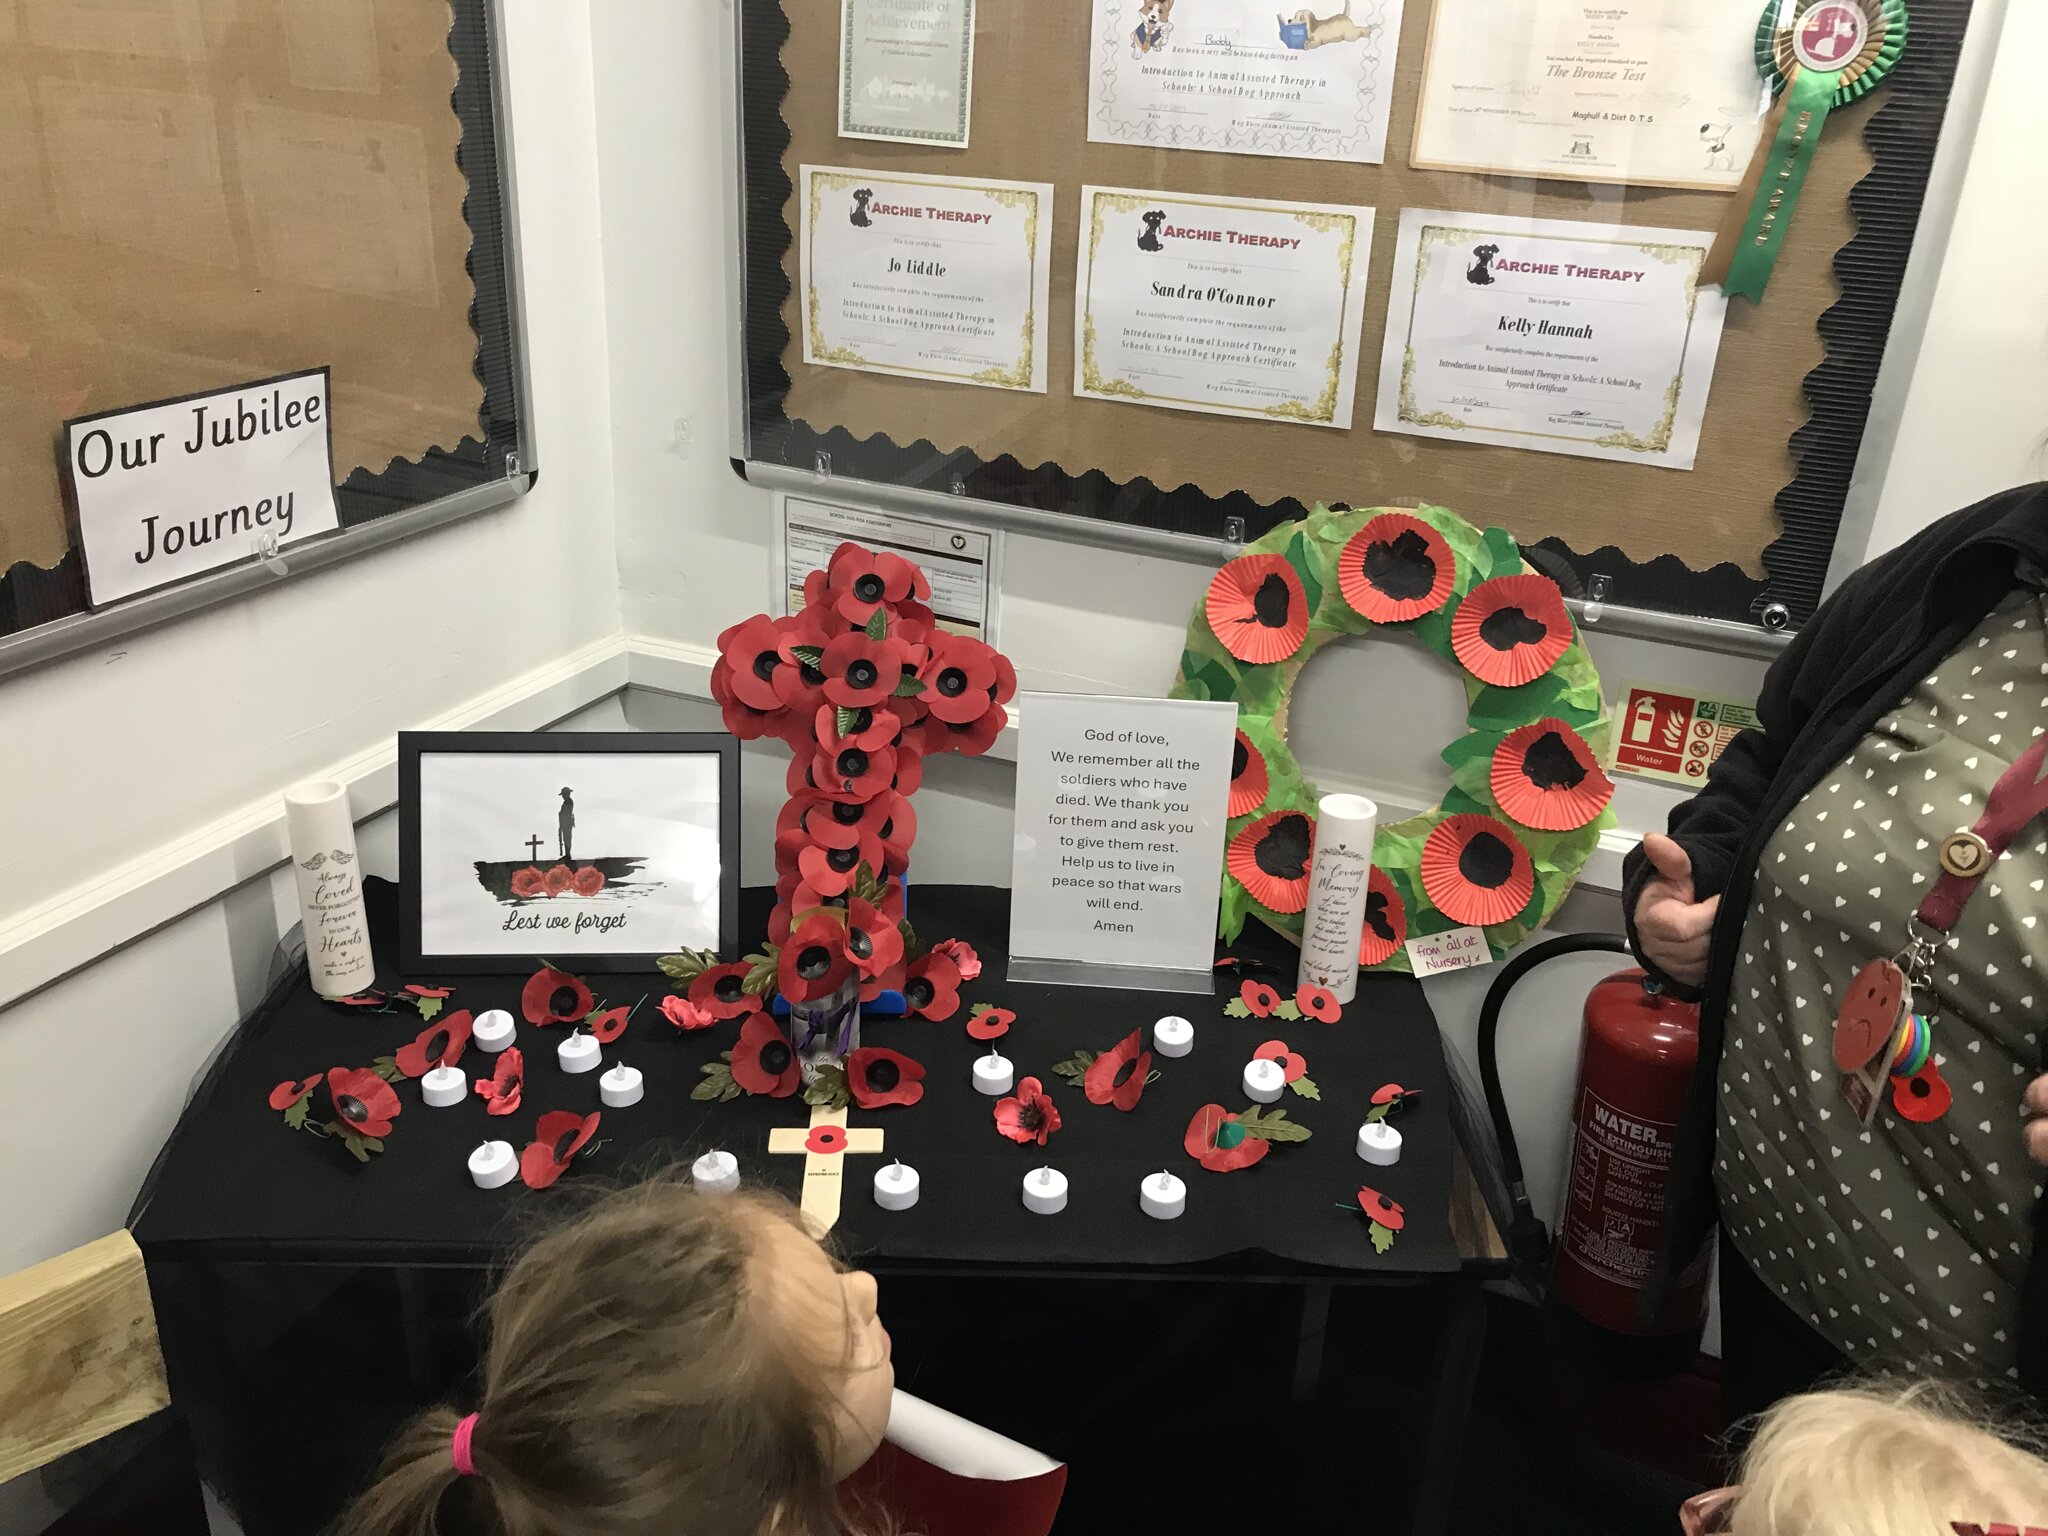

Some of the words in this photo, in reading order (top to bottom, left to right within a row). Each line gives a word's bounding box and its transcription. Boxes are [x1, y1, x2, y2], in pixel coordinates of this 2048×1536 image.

[865, 14, 950, 31] Achievement
[1142, 65, 1193, 78] Introduction
[1196, 70, 1204, 78] to
[1208, 70, 1239, 81] Animal
[1240, 71, 1276, 83] Assisted
[1280, 75, 1315, 88] Therapy
[1318, 78, 1326, 86] in
[1546, 64, 1569, 77] The
[1572, 66, 1617, 80] Bronze
[1622, 68, 1646, 81] Test
[1208, 85, 1236, 96] School
[1238, 88, 1255, 98] Dog
[1258, 90, 1300, 100] Approach
[1572, 111, 1600, 121] Maghull
[888, 258, 901, 272] Jo
[907, 259, 946, 278] Liddle
[1150, 281, 1202, 301] Sandra
[1206, 287, 1276, 308] O'Connor
[842, 298, 885, 311] Introduction
[898, 306, 922, 316] Animal
[924, 308, 954, 320] Assisted
[956, 312, 986, 325] Therapy
[879, 314, 902, 325] School
[904, 318, 918, 328] Dog
[920, 321, 955, 332] Approach
[958, 325, 995, 336] Certificate
[1498, 316, 1535, 336] Kelly
[1538, 320, 1593, 339] Hannah
[1122, 328, 1171, 341] Introduction
[1174, 334, 1182, 342] to
[1186, 335, 1214, 346] Animal
[1216, 338, 1250, 350] Assisted
[1253, 342, 1286, 356] Therapy
[1164, 345, 1190, 356] School
[1192, 348, 1208, 359] Dog
[1210, 351, 1250, 362] Approach
[1254, 356, 1296, 368] Certificate
[1439, 359, 1476, 371] Introduction
[1486, 364, 1508, 374] Animal
[1510, 368, 1534, 378] Assisted
[1536, 370, 1562, 382] Therapy
[1606, 378, 1628, 387] School
[1628, 380, 1642, 390] Dog
[1505, 379, 1534, 390] Approach
[1536, 383, 1568, 394] Certificate
[78, 430, 165, 478] Our
[185, 390, 320, 454] Jubilee
[134, 492, 294, 564] Journey
[1084, 729, 1114, 742] God
[1118, 730, 1132, 742] of
[1136, 732, 1169, 746] love,
[1051, 750, 1074, 763] We
[1078, 753, 1152, 768] remember
[1156, 758, 1173, 769] all
[1176, 759, 1200, 771] the
[1636, 754, 1663, 766] Water
[1060, 773, 1116, 787] soldiers
[1120, 777, 1150, 788] who
[1154, 778, 1187, 791] have
[1056, 794, 1090, 806] died.
[1094, 796, 1117, 808] We
[1120, 798, 1160, 810] thank
[1164, 802, 1189, 812] you
[1048, 814, 1068, 826] for
[1071, 816, 1106, 828] them
[1111, 818, 1136, 830] and
[1140, 820, 1164, 832] ask
[1168, 822, 1194, 834] you
[1060, 836, 1073, 846] to
[1077, 837, 1104, 850] give
[1108, 838, 1144, 850] them
[1148, 842, 1178, 853] rest.
[1062, 856, 1094, 870] Help
[1098, 860, 1114, 870] us
[1118, 860, 1132, 870] to
[1135, 860, 1158, 872] live
[1162, 862, 1174, 873] in
[1315, 859, 1326, 871] In
[1330, 864, 1364, 882] Loving
[316, 872, 346, 884] Always
[1052, 876, 1094, 889] peace
[1098, 880, 1114, 890] so
[1118, 879, 1145, 892] that
[1148, 883, 1182, 894] wars
[1318, 878, 1360, 898] Memory
[313, 876, 354, 904] Loved
[1086, 898, 1110, 909] will
[1114, 899, 1143, 911] end.
[338, 926, 351, 934] OUR
[502, 910, 542, 930] Lest
[546, 916, 571, 930] we
[574, 912, 627, 934] forget
[1094, 920, 1134, 932] Amen
[319, 928, 362, 952] Hearts
[1416, 944, 1441, 958] from
[1446, 939, 1462, 952] all
[1464, 936, 1478, 948] at
[1426, 954, 1472, 970] Nursery
[1589, 1121, 1605, 1140] FIRE
[1594, 1104, 1658, 1144] WATER
[1622, 1160, 1652, 1175] UPRIGHT
